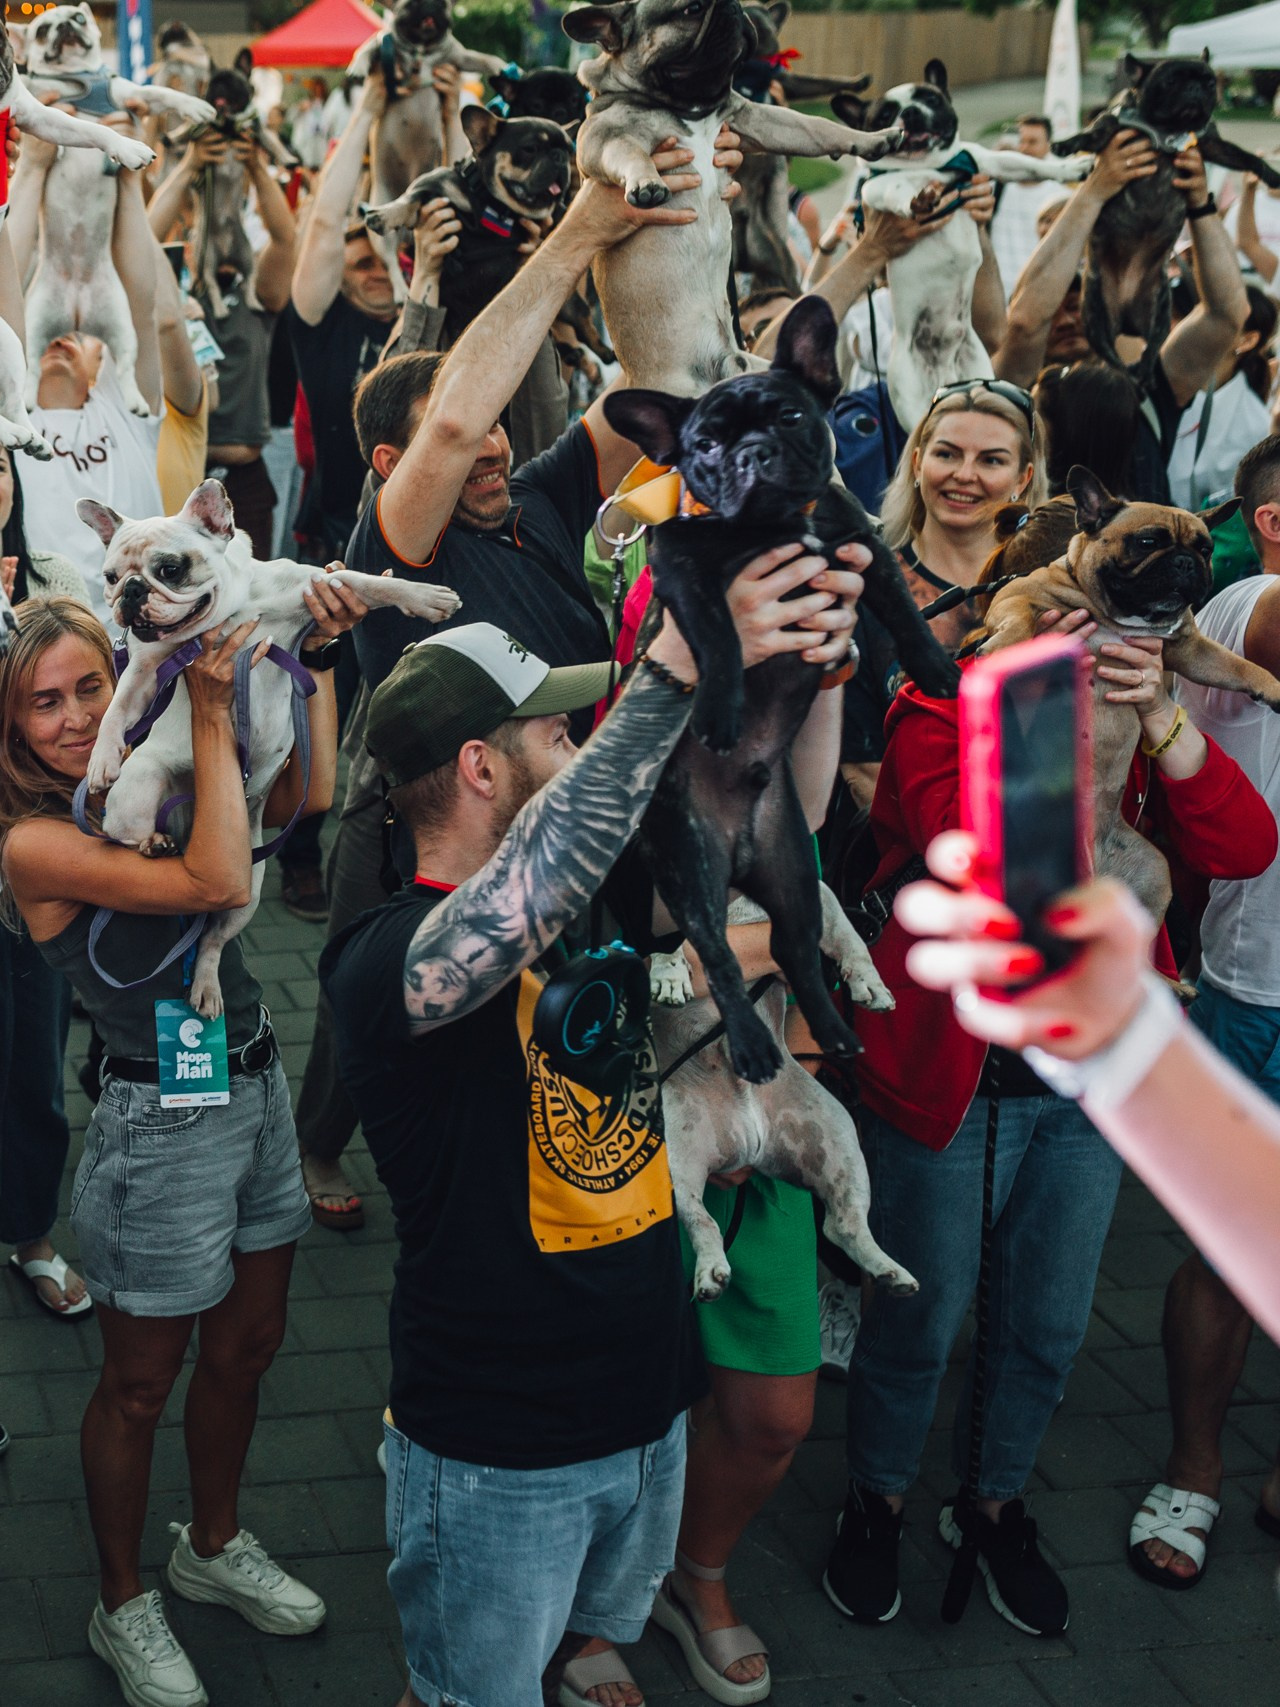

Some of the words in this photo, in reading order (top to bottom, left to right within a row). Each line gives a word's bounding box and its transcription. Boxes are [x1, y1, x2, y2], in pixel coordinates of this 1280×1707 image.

[176, 1050, 212, 1066] Море
[175, 1061, 213, 1081] Лап
[528, 1080, 568, 1176] SKATEBOARD
[623, 1149, 649, 1177] 1994
[566, 1170, 616, 1191] ATHLETIC
